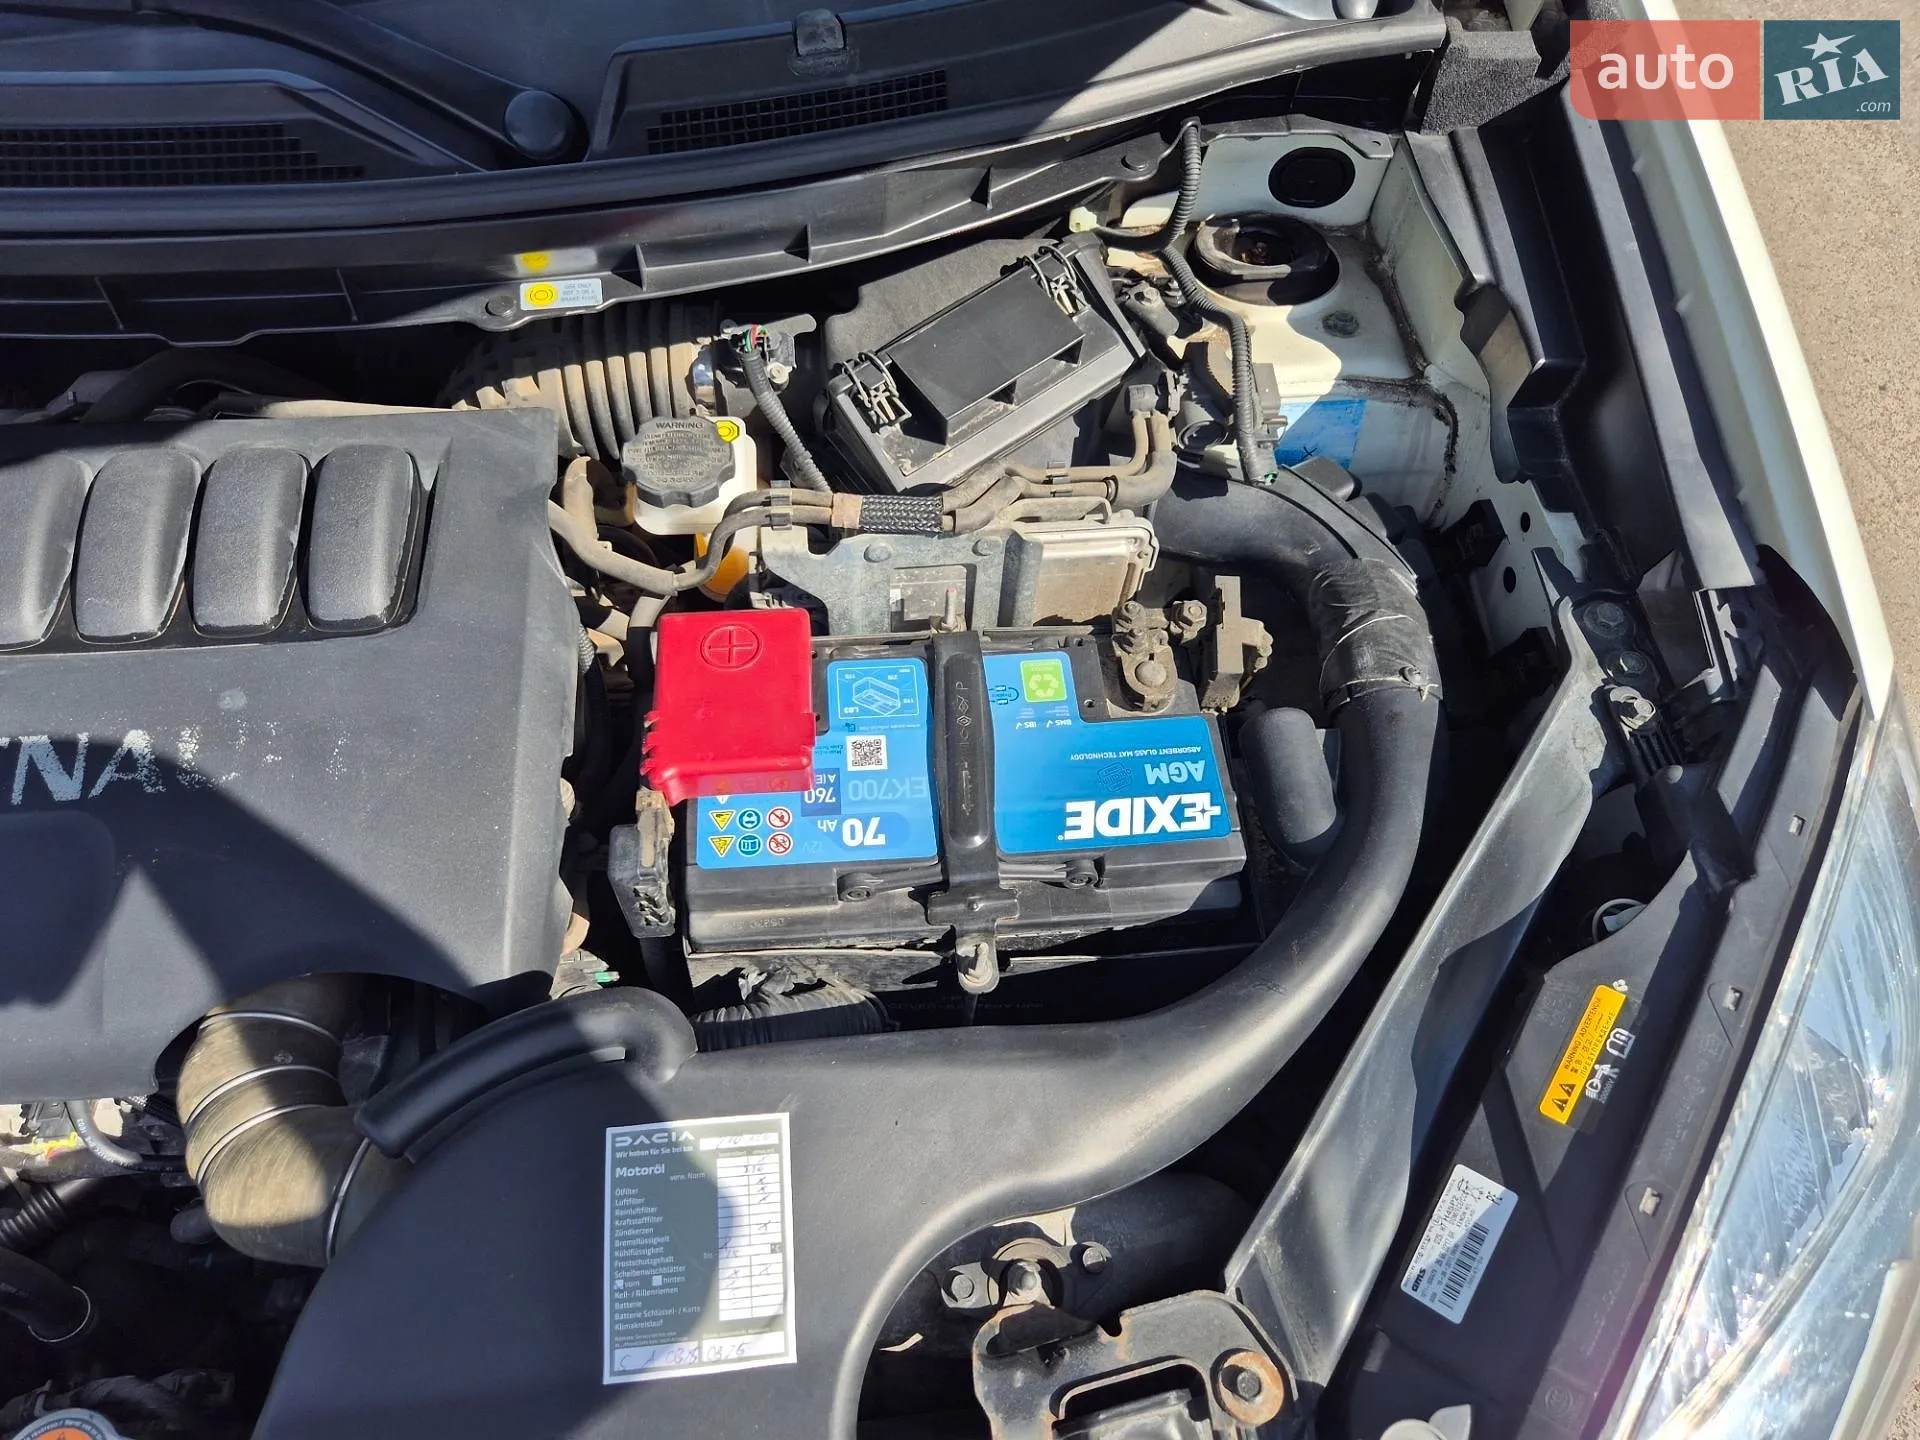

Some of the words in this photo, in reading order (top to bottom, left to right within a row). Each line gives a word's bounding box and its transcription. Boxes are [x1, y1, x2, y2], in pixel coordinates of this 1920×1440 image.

[655, 422, 704, 430] WARNING
[1069, 751, 1117, 761] TECHNOLOGY
[1118, 750, 1134, 758] MAT
[1134, 748, 1158, 757] GLASS
[1158, 745, 1202, 756] ABSORBENT
[1143, 759, 1206, 785] AGM
[848, 776, 928, 802] EK700
[804, 787, 836, 804] 760
[1064, 792, 1221, 841] EXIDE
[816, 818, 838, 832] Ah
[841, 816, 887, 847] 70
[615, 1131, 695, 1148] DACIA
[615, 1150, 628, 1159] Wir
[628, 1149, 649, 1158] haben
[650, 1148, 660, 1156] für
[661, 1147, 670, 1155] Sie
[672, 1145, 682, 1154] bei
[615, 1163, 665, 1178] Motoröl
[615, 1197, 646, 1206] Luftfilter
[615, 1227, 654, 1237] Zündkerzen
[615, 1235, 670, 1247] Bremsflüssigkeit
[615, 1246, 664, 1258] Kühlflüssigkeit
[614, 1265, 686, 1279] Scheibenwischblätter
[663, 1275, 685, 1284] hinten
[1411, 1268, 1427, 1292] ams
[615, 1300, 642, 1309] Batterie
[614, 1311, 641, 1320] Batterie
[615, 1319, 663, 1331] Klimakreislauf
